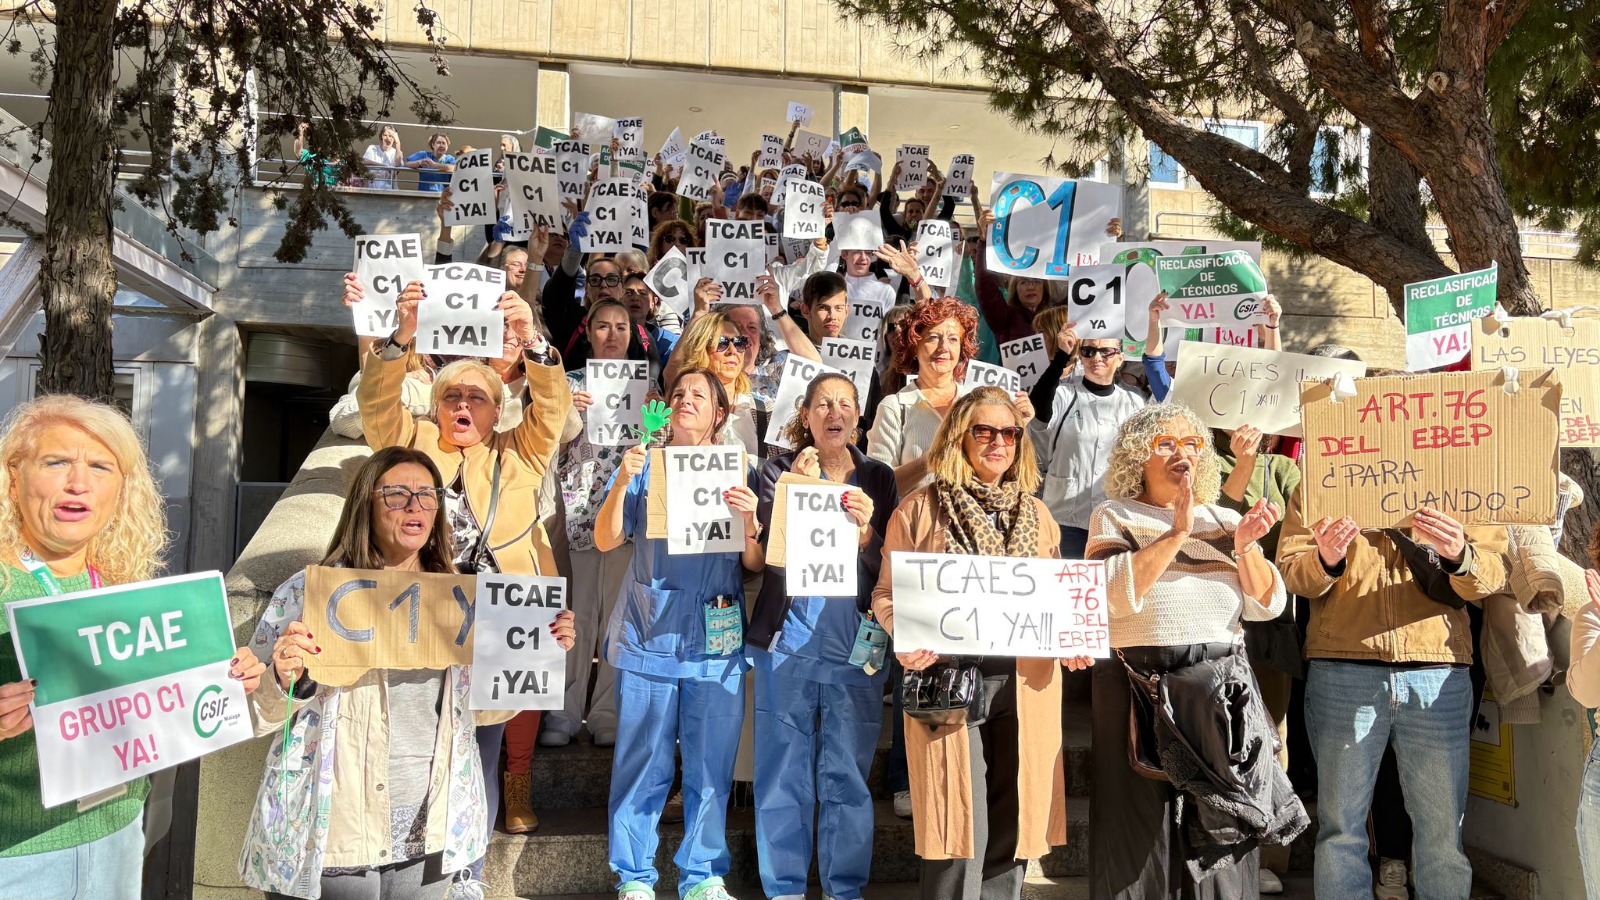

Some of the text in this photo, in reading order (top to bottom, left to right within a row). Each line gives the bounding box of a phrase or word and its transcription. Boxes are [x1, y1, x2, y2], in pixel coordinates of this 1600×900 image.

[617, 120, 642, 128] TCAE
[623, 133, 635, 141] C1
[763, 135, 783, 145] TCAE
[554, 142, 590, 155] TCAE
[619, 147, 638, 156] ¡YA!
[690, 143, 723, 165] TCAE
[905, 147, 928, 155] TCAE
[456, 153, 490, 172] TCAE
[505, 154, 556, 174] TCAE
[562, 161, 579, 173] C1
[952, 156, 974, 165] TCAE
[694, 166, 709, 180] C1
[781, 167, 804, 177] TCAE
[905, 173, 922, 181] ¡YA!
[953, 170, 965, 179] C1
[459, 178, 479, 192] C1
[523, 185, 543, 202] C1
[560, 181, 582, 194] YA!
[592, 183, 629, 198] TCAE
[791, 182, 823, 197] TCAE
[947, 185, 967, 194] ¡YA!
[455, 203, 487, 220] ¡YA!
[596, 207, 616, 221] C1
[800, 203, 814, 214] C1
[709, 222, 763, 239] TCAE
[793, 222, 817, 234] ¡YA!
[921, 224, 950, 238] TCAE
[992, 179, 1077, 276] C1
[590, 231, 622, 247] ¡YA!
[357, 239, 418, 259] TCAE
[926, 245, 942, 257] C1
[724, 252, 748, 268] C1
[428, 266, 501, 284] TCAE
[919, 265, 943, 278] YA!
[1200, 271, 1215, 282] DE
[373, 275, 401, 293] C1
[722, 282, 754, 298] YA!
[1181, 284, 1238, 297] TÉCNICOS
[445, 293, 478, 310] C1
[1238, 304, 1259, 313] CSIF
[1456, 294, 1473, 307] DE
[1181, 303, 1215, 319] YA!
[1434, 305, 1491, 327] TÉCNICOS
[1090, 320, 1106, 329] YA
[432, 325, 488, 350] ¡YA!
[862, 328, 879, 341] C1
[827, 343, 873, 361] TCAE
[1002, 337, 1043, 358] TCAE
[1432, 331, 1467, 356] YA!
[1481, 346, 1600, 368] LAS LEYES
[589, 362, 647, 380] TCAE
[1017, 363, 1036, 377] C1
[1198, 355, 1280, 382] TCAES
[971, 365, 1018, 392] TCAE
[606, 393, 631, 411] C1
[1561, 415, 1599, 427] DEL
[598, 424, 639, 443] ¡YA!
[1318, 422, 1493, 456] DEL EBEP
[674, 453, 738, 471] TCAE
[1321, 459, 1423, 488] ¿PARA
[693, 487, 721, 506] C1
[685, 521, 731, 546] ¡YA!
[810, 528, 836, 547] C1
[801, 563, 844, 588] ¡YA!
[905, 559, 1036, 596] TCAES
[1054, 563, 1103, 587] ART.
[486, 582, 562, 609] TCAE
[1068, 588, 1099, 610] 76
[326, 579, 477, 647] C1 Y
[1072, 613, 1108, 627] DEL
[78, 610, 188, 666] TCAE
[506, 627, 540, 650] C1
[1003, 612, 1053, 651] YA!!!
[1058, 630, 1108, 649] EBEP
[492, 670, 549, 700] ¡YA!
[59, 682, 186, 741] GRUPO C1
[200, 697, 229, 721] CSIF
[112, 734, 159, 772] YA!
